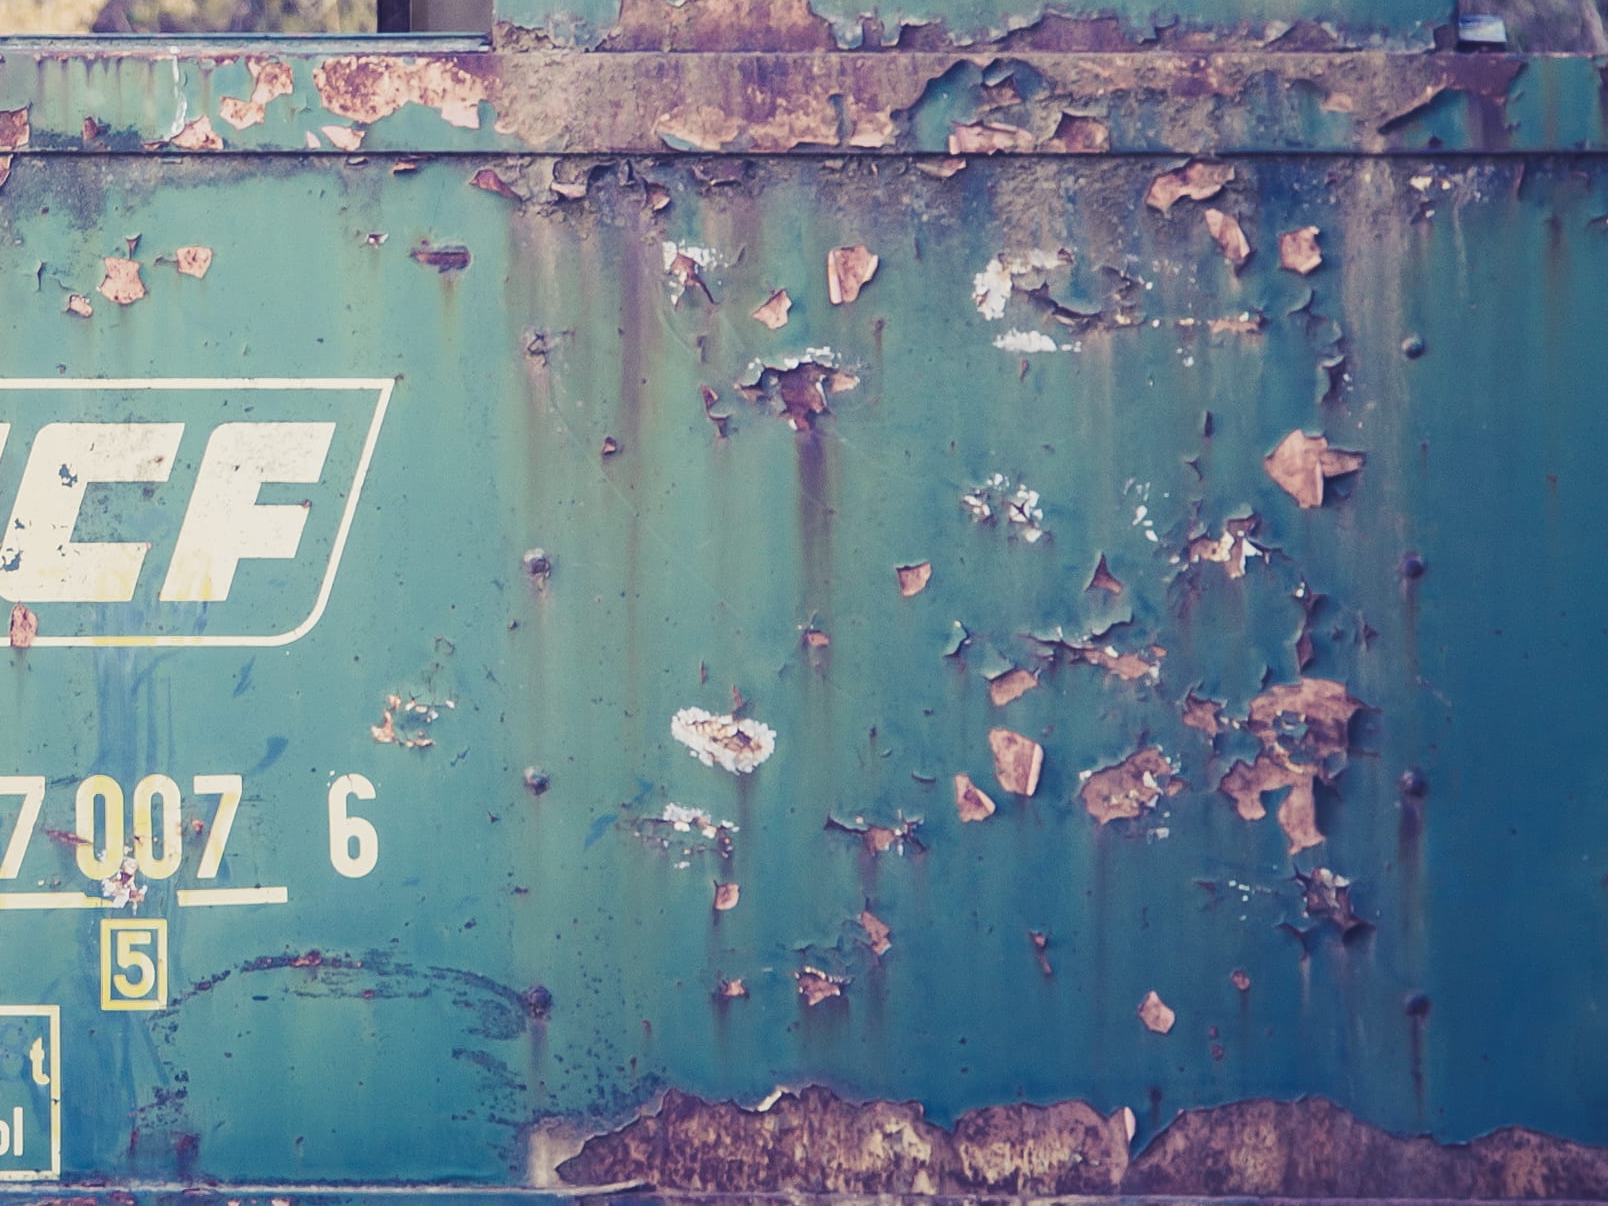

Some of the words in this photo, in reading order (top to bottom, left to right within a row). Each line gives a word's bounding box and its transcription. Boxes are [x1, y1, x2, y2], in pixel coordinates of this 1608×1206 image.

[74, 773, 243, 880] 007
[328, 773, 379, 878] 6
[112, 930, 155, 999] 5
[29, 1036, 51, 1086] t
